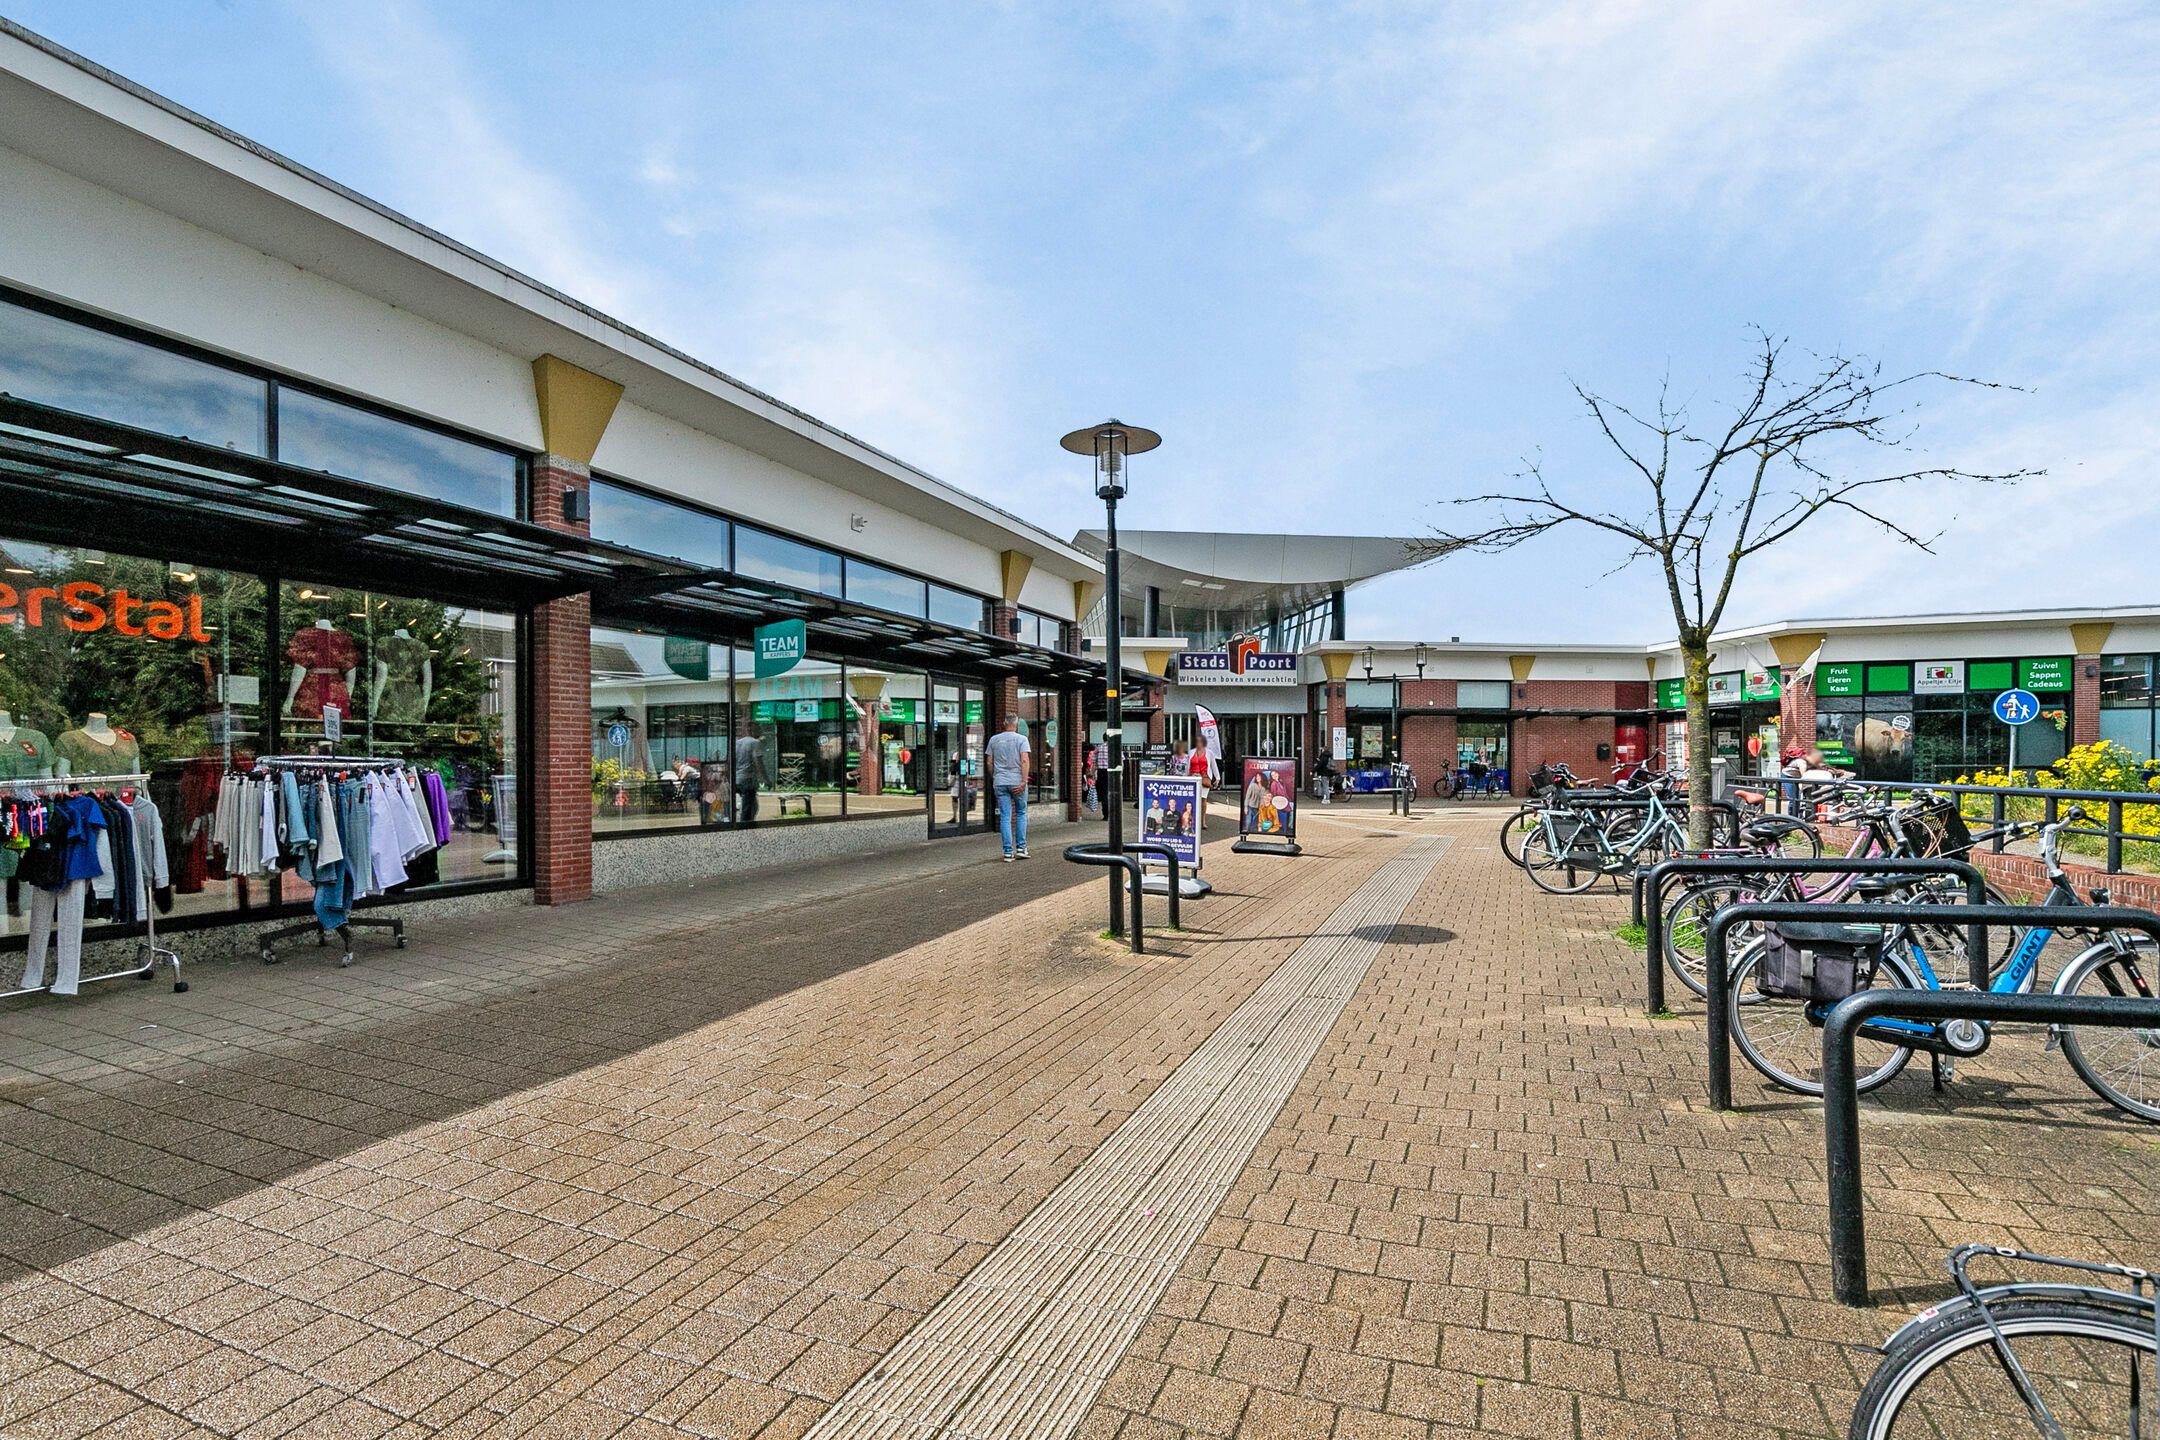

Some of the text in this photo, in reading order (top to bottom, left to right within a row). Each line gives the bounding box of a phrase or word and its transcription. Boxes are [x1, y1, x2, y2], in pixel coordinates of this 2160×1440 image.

[760, 636, 798, 651] TEAM
[1184, 655, 1291, 669] Stads Poort
[2032, 662, 2059, 670] Zuivel
[1179, 675, 1297, 684] Winkelen boven verwachting
[1827, 676, 1852, 684] Eieren
[2029, 671, 2061, 680] Sappen
[1829, 685, 1849, 693] Kaas
[1158, 783, 1194, 791] ANYTIME
[2010, 930, 2042, 981] GIANT
